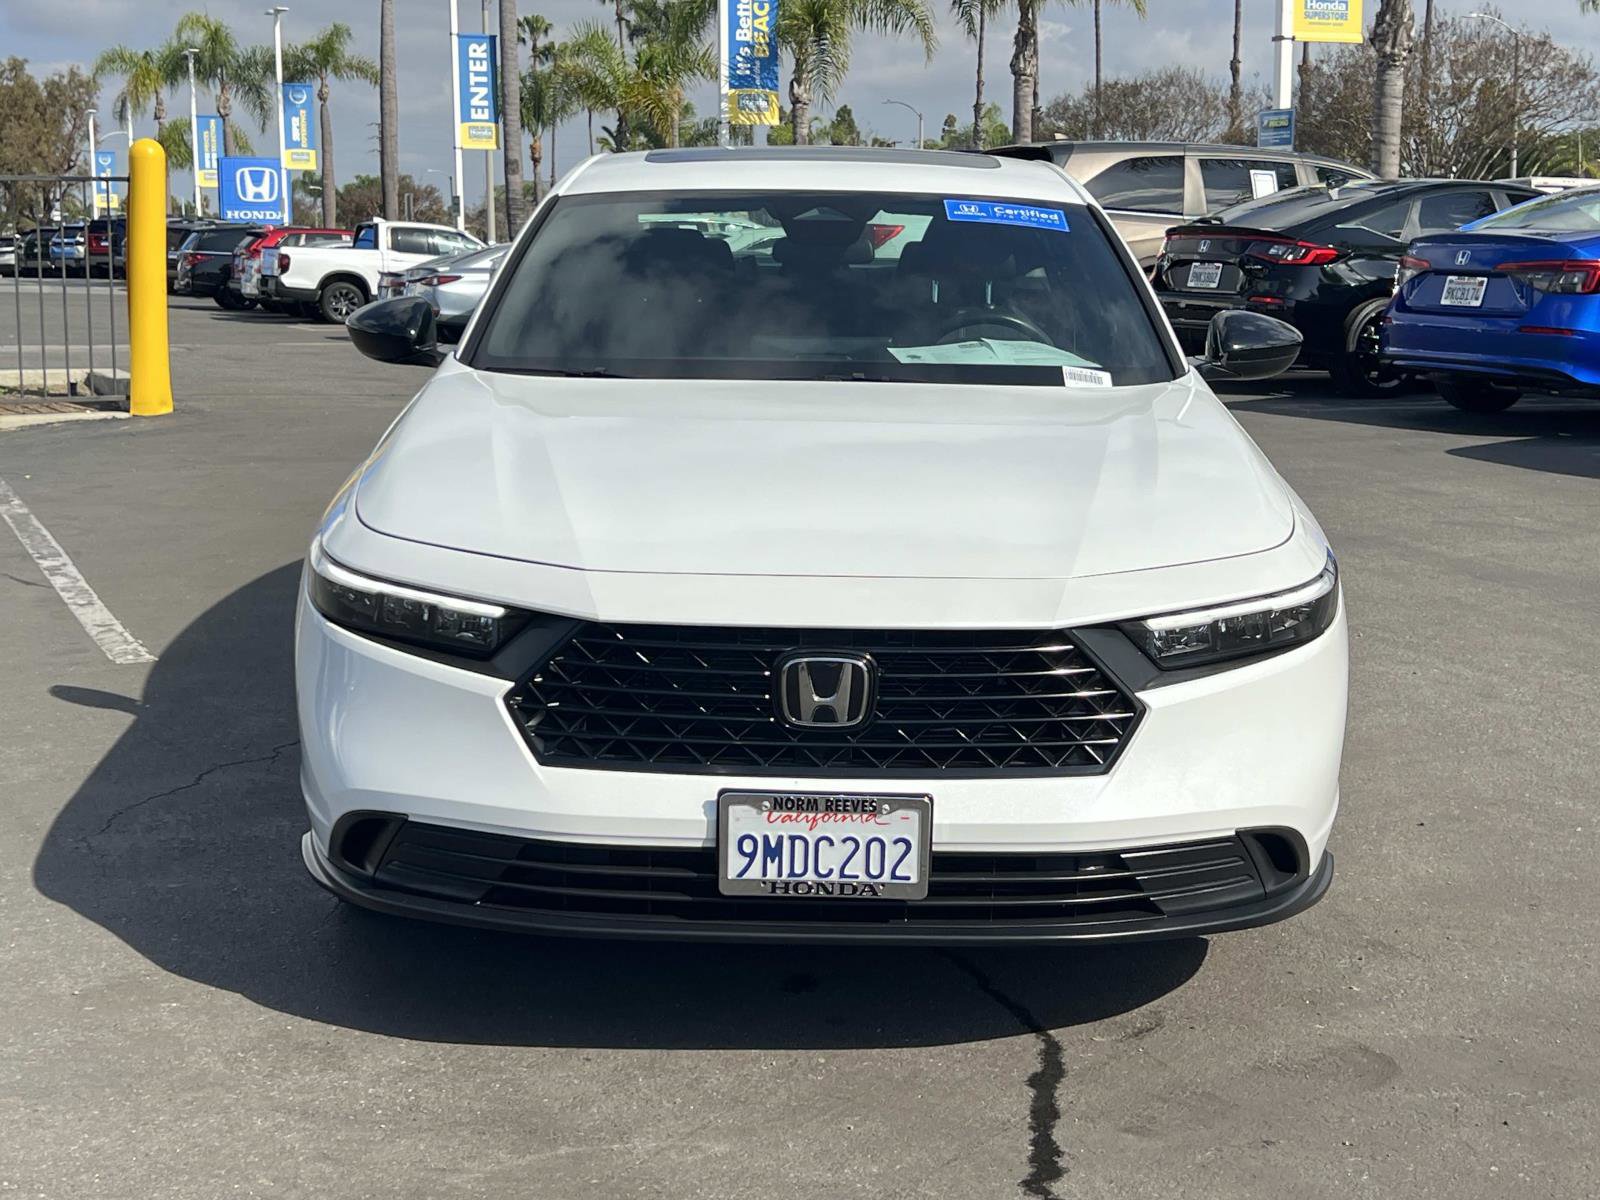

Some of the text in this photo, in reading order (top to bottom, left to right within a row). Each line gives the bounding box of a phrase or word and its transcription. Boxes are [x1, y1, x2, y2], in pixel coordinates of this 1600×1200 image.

[1307, 0, 1346, 10] Honda
[1304, 11, 1349, 20] SUPERSTORE
[736, 46, 751, 75] It's
[468, 42, 489, 120] ENTER
[291, 117, 300, 142] SUPER
[994, 206, 1059, 220] Certified
[773, 797, 877, 813] NORM REEVES
[766, 810, 891, 832] California
[736, 833, 913, 881] 9MDC202
[768, 881, 881, 896] HONDA
